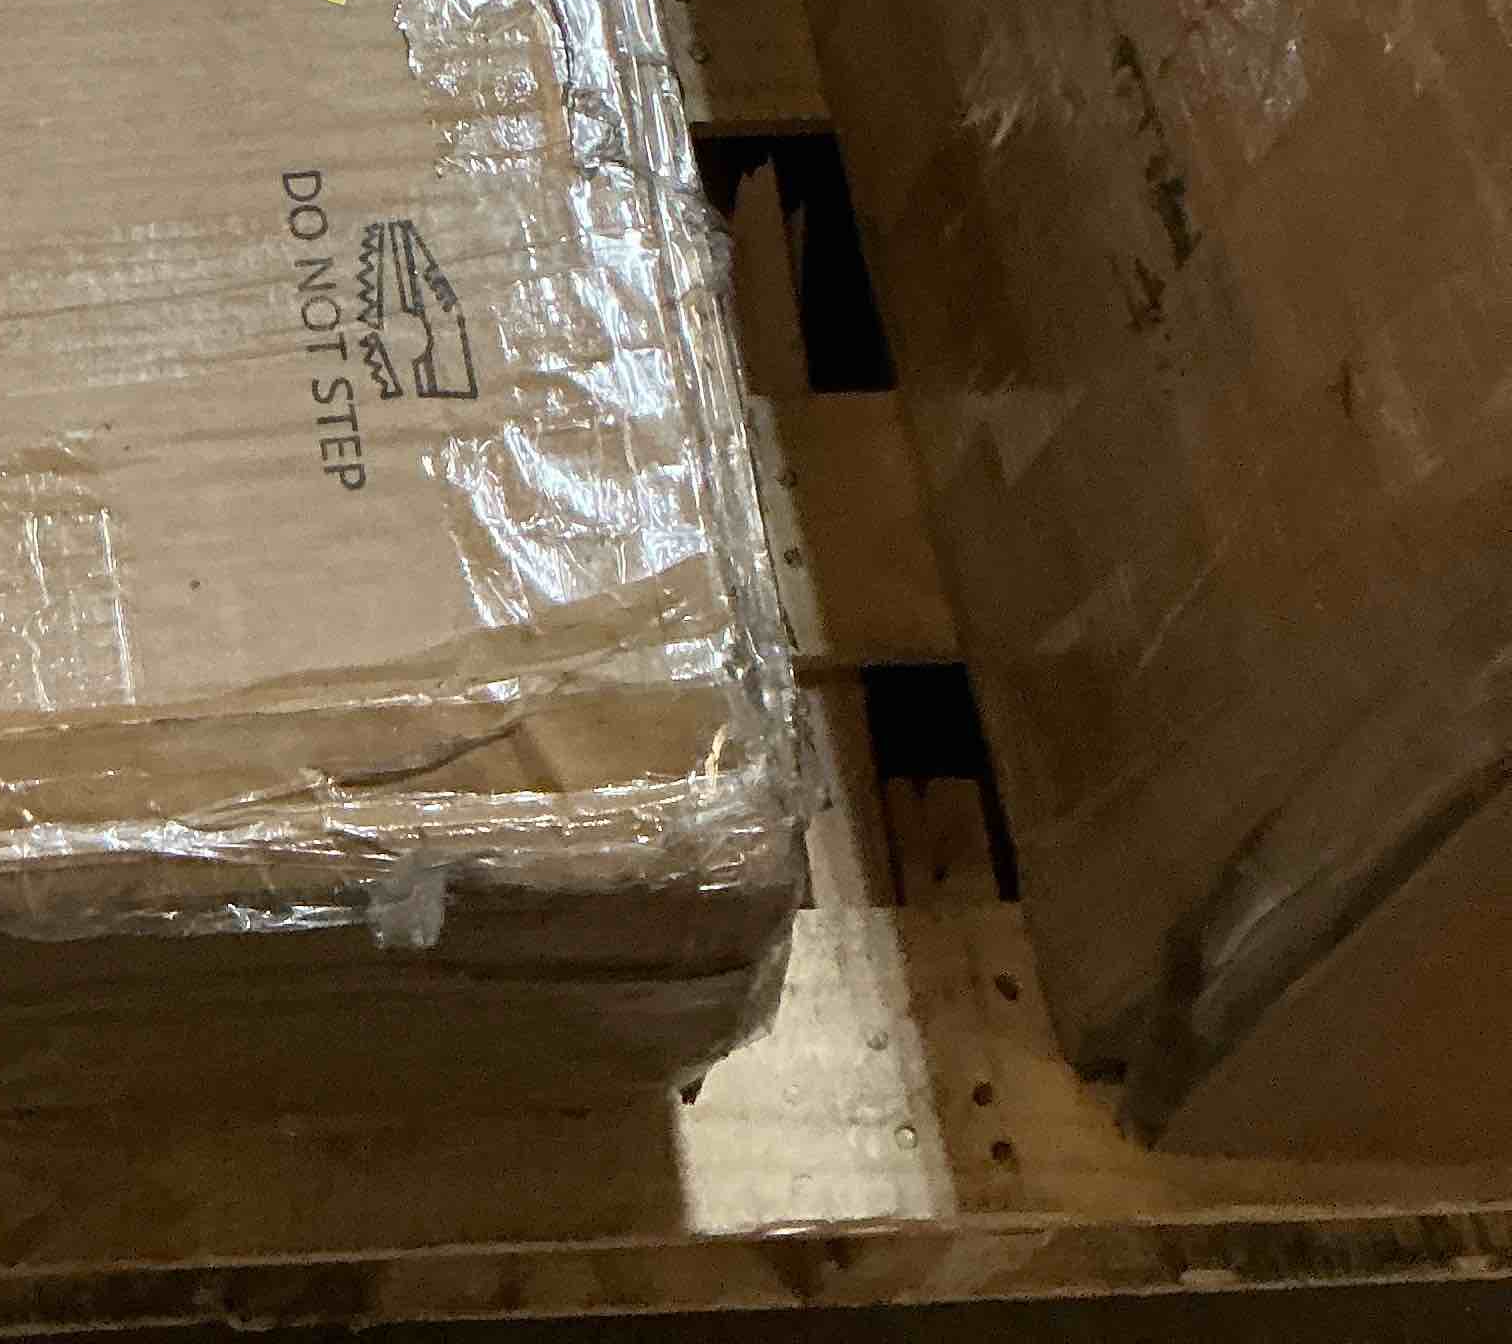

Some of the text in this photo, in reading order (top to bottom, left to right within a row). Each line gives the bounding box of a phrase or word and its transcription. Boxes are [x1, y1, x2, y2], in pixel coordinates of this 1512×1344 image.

[282, 169, 367, 492] DO NOT STEP
